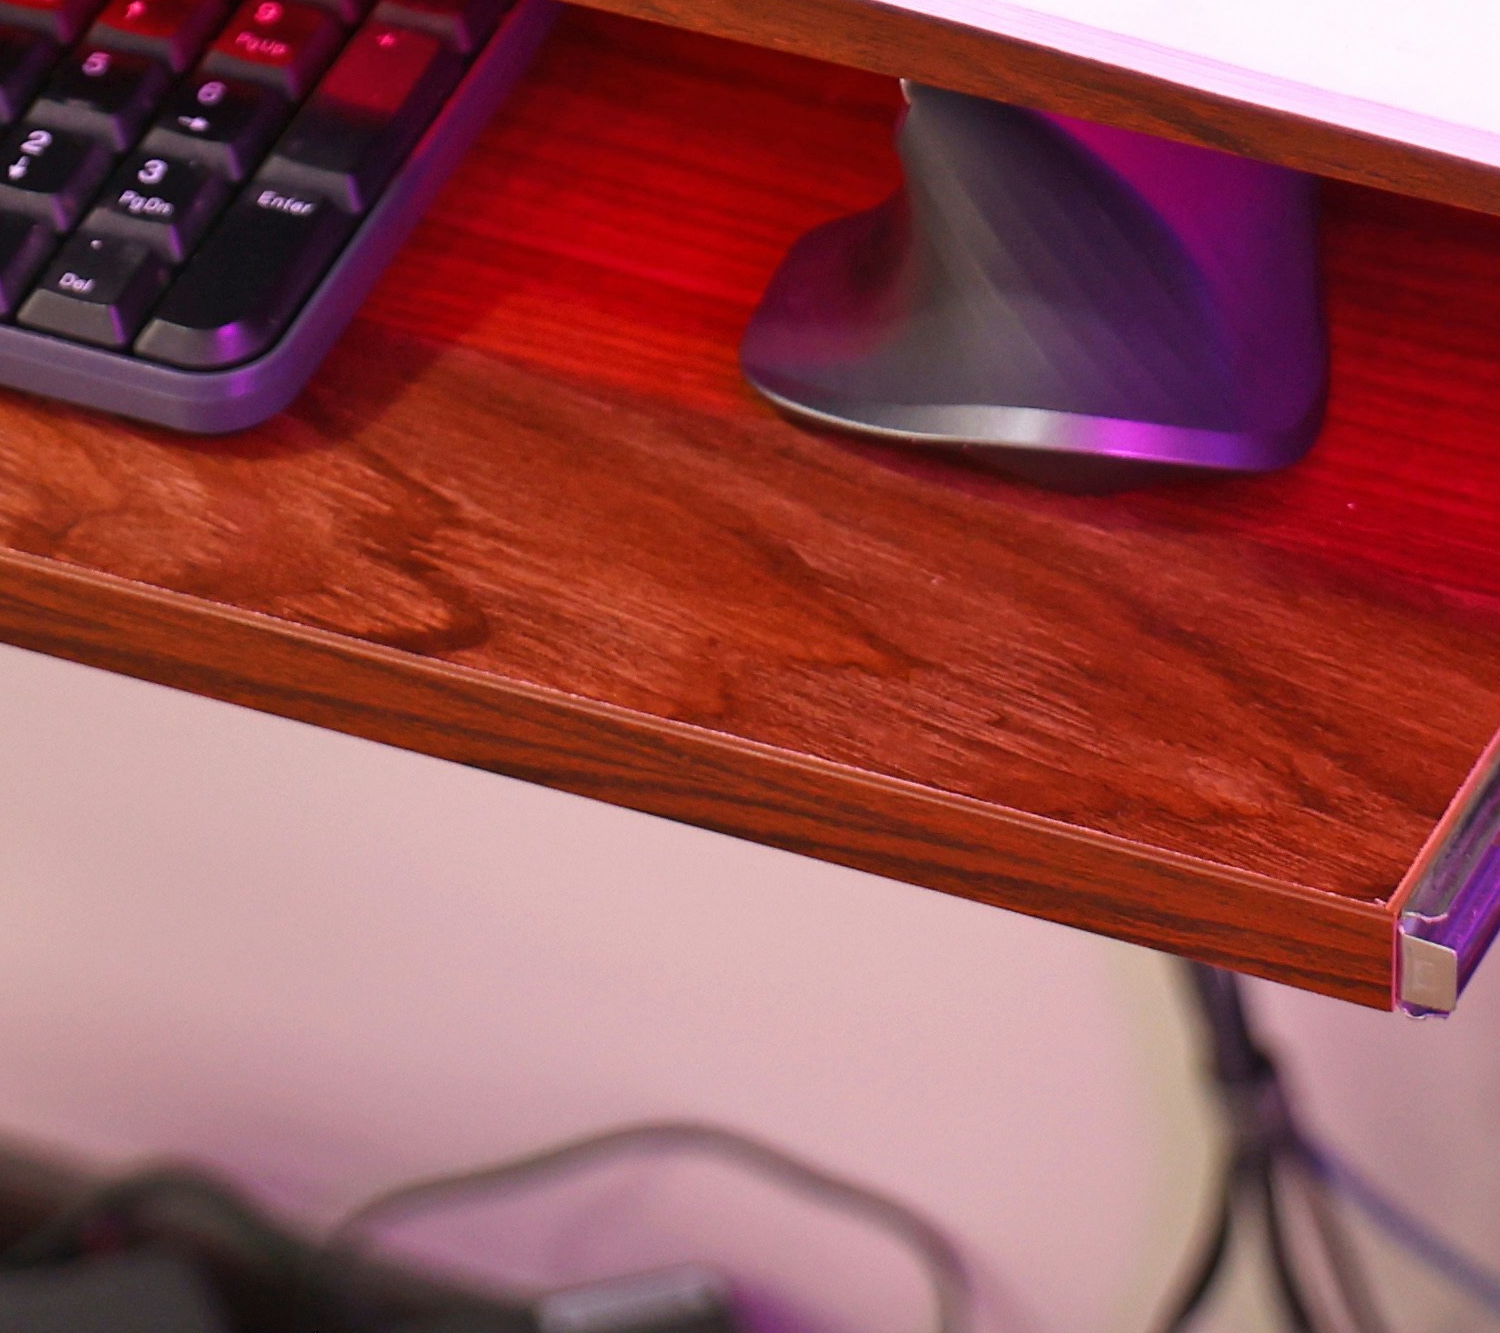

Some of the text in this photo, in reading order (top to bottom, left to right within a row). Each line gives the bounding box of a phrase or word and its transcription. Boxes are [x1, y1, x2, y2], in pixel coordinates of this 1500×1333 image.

[253, 0, 285, 25] 9
[196, 80, 228, 106] 6
[19, 129, 53, 158] 2
[136, 158, 170, 185] 3
[117, 188, 176, 218] PgDn
[256, 189, 317, 217] Enter
[57, 270, 97, 295] Del
